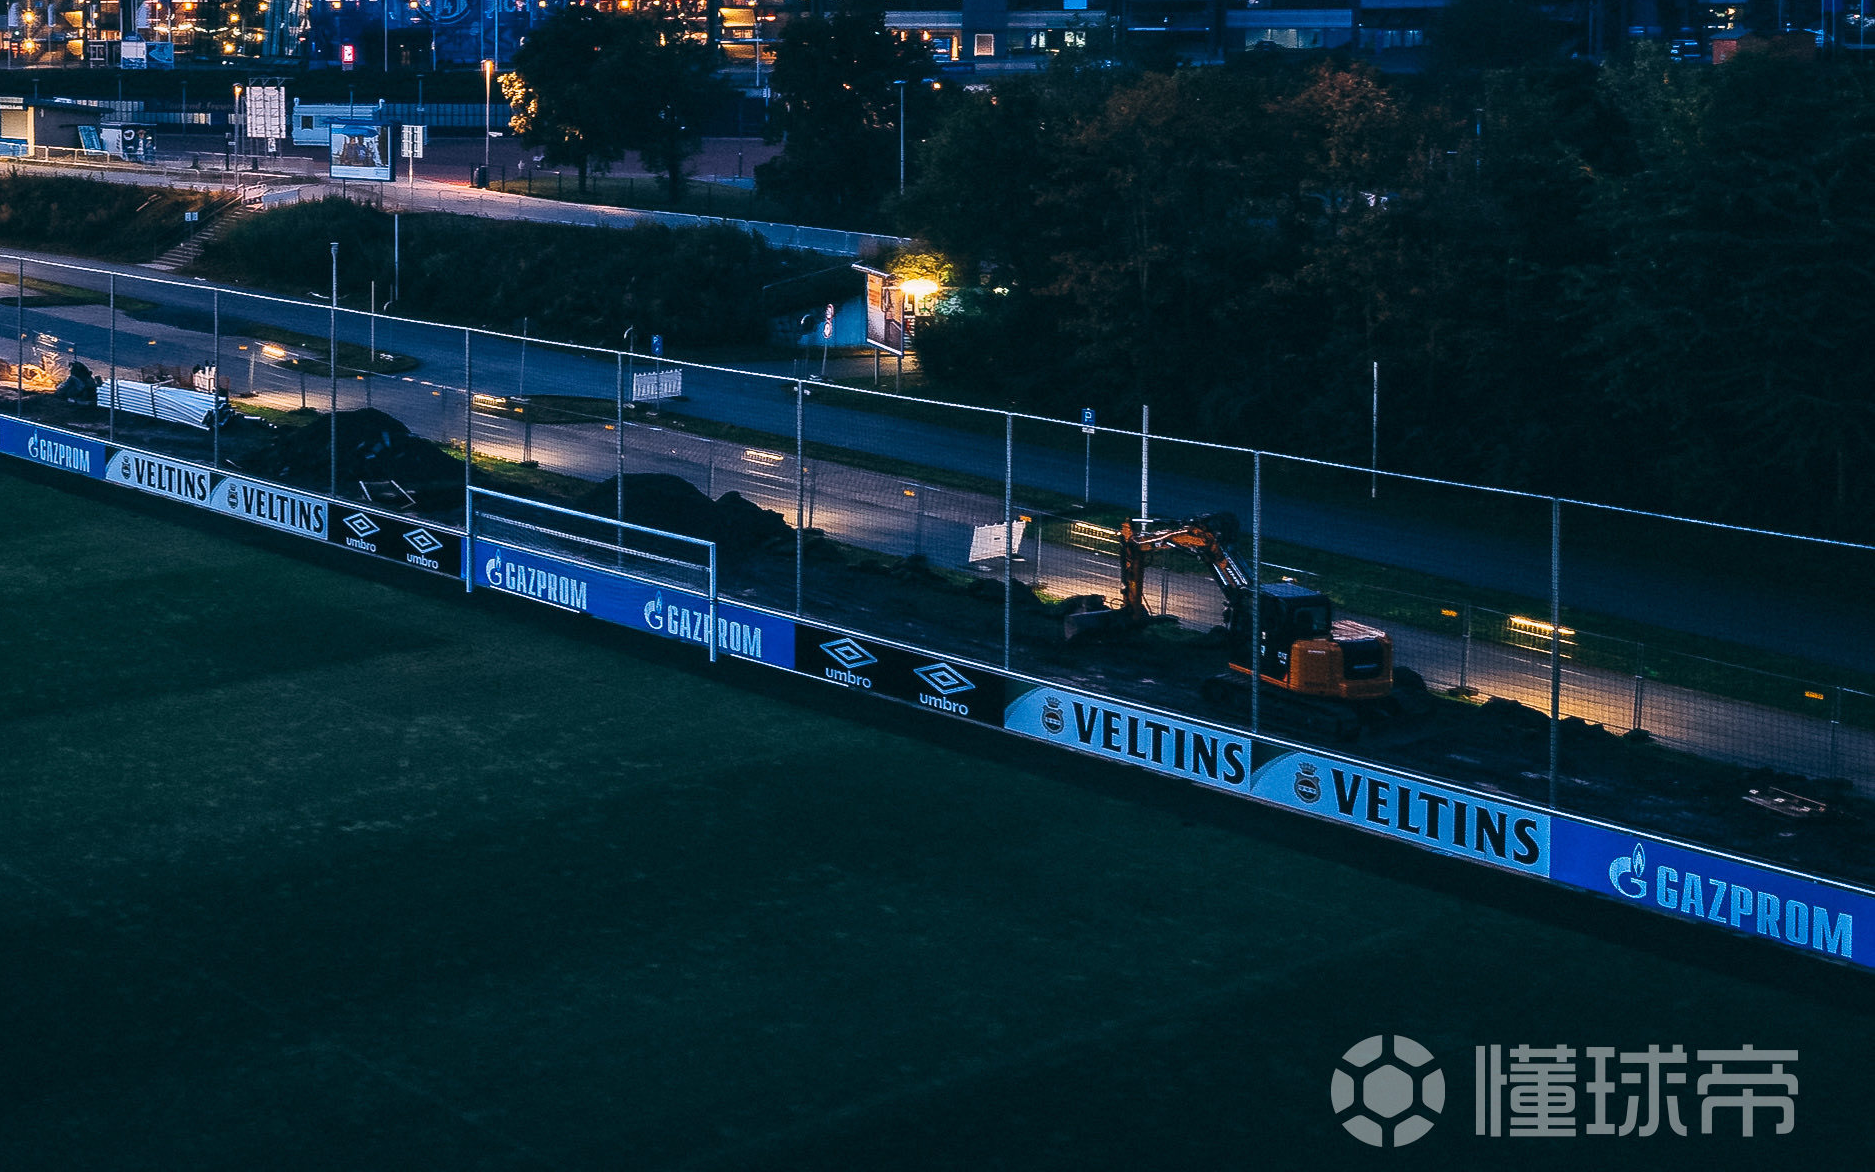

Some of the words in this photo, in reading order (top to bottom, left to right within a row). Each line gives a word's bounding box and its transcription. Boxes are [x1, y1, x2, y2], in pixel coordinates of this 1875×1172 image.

[39, 439, 91, 473] GAZPROM
[134, 457, 208, 502] VELTINS
[242, 485, 324, 534] VELTINS
[345, 536, 377, 553] umbro
[406, 552, 439, 570] umbro
[505, 561, 587, 611] GAZPROM
[825, 666, 872, 689] umbro
[919, 691, 969, 716] umbro
[1072, 701, 1246, 785] VELTINS
[1331, 768, 1540, 865] VELTINS
[1656, 864, 1854, 959] GAZPROM
